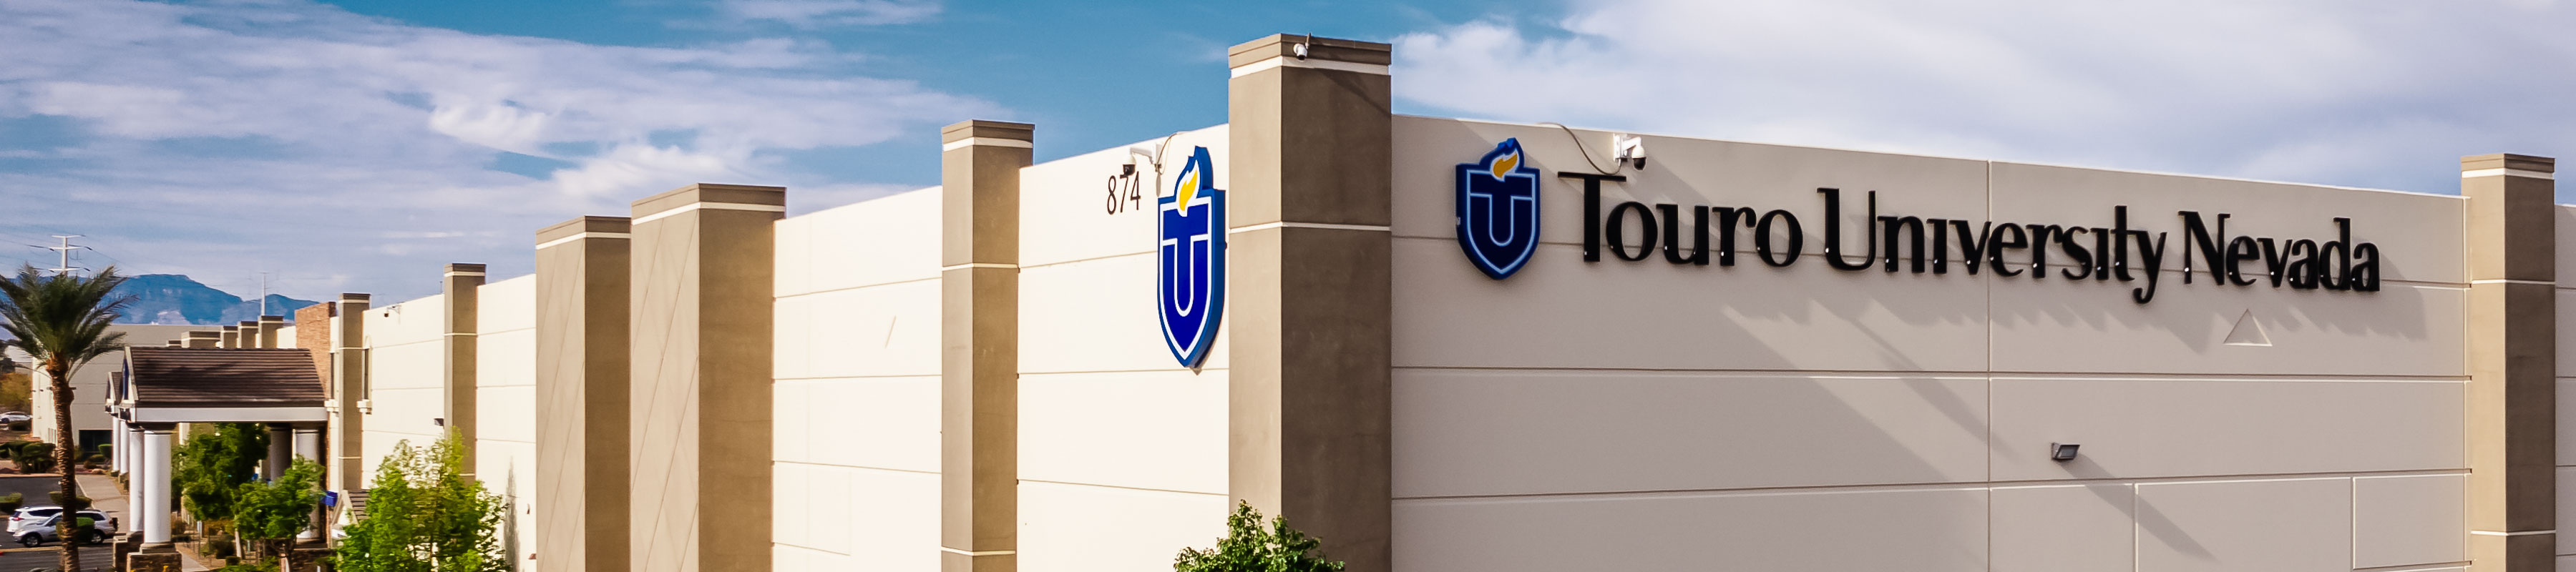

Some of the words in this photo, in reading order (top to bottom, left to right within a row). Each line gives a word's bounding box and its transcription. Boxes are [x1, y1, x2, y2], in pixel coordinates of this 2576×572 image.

[1106, 172, 1141, 215] 874
[1557, 171, 1803, 267] Touro
[1817, 187, 2167, 305] University
[2178, 210, 2381, 292] Nevada
